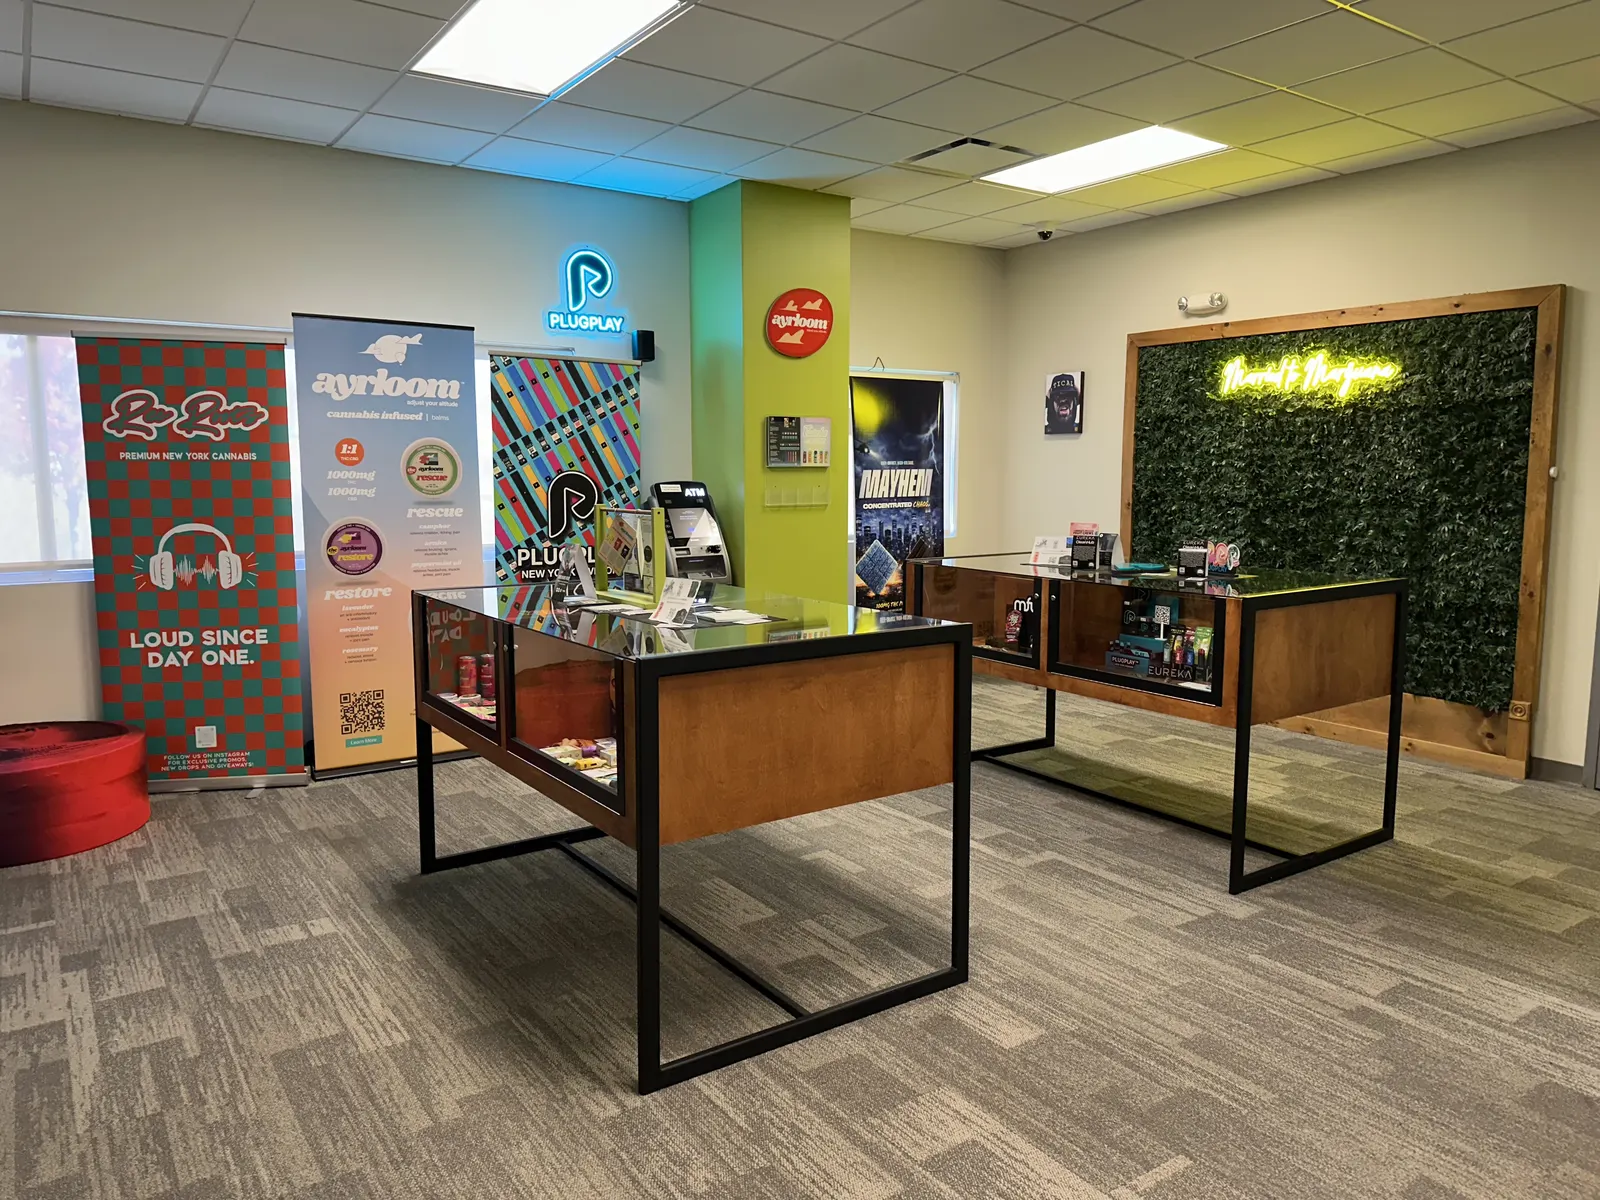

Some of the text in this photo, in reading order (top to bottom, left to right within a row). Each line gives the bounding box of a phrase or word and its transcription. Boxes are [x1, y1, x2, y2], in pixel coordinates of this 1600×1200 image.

[549, 312, 624, 332] PLUGPLAY
[772, 313, 828, 329] ayrloom
[312, 368, 460, 400] ayrloom
[327, 410, 380, 419] cannabis
[381, 411, 423, 420] infused
[340, 444, 358, 454] 1:1
[120, 452, 257, 461] PREMIUM NEW YORK CANNABIS
[327, 470, 376, 481] 1000mg
[859, 469, 934, 499] MAYHEM
[328, 487, 376, 497] 1000mg
[685, 488, 705, 496] ATM
[407, 508, 463, 518] rescue
[522, 570, 545, 579] NEW
[324, 587, 392, 600] restore
[130, 629, 268, 648] LOUD SINCE
[148, 649, 255, 668] DAY ONE.
[1148, 666, 1192, 680] EUREKA
